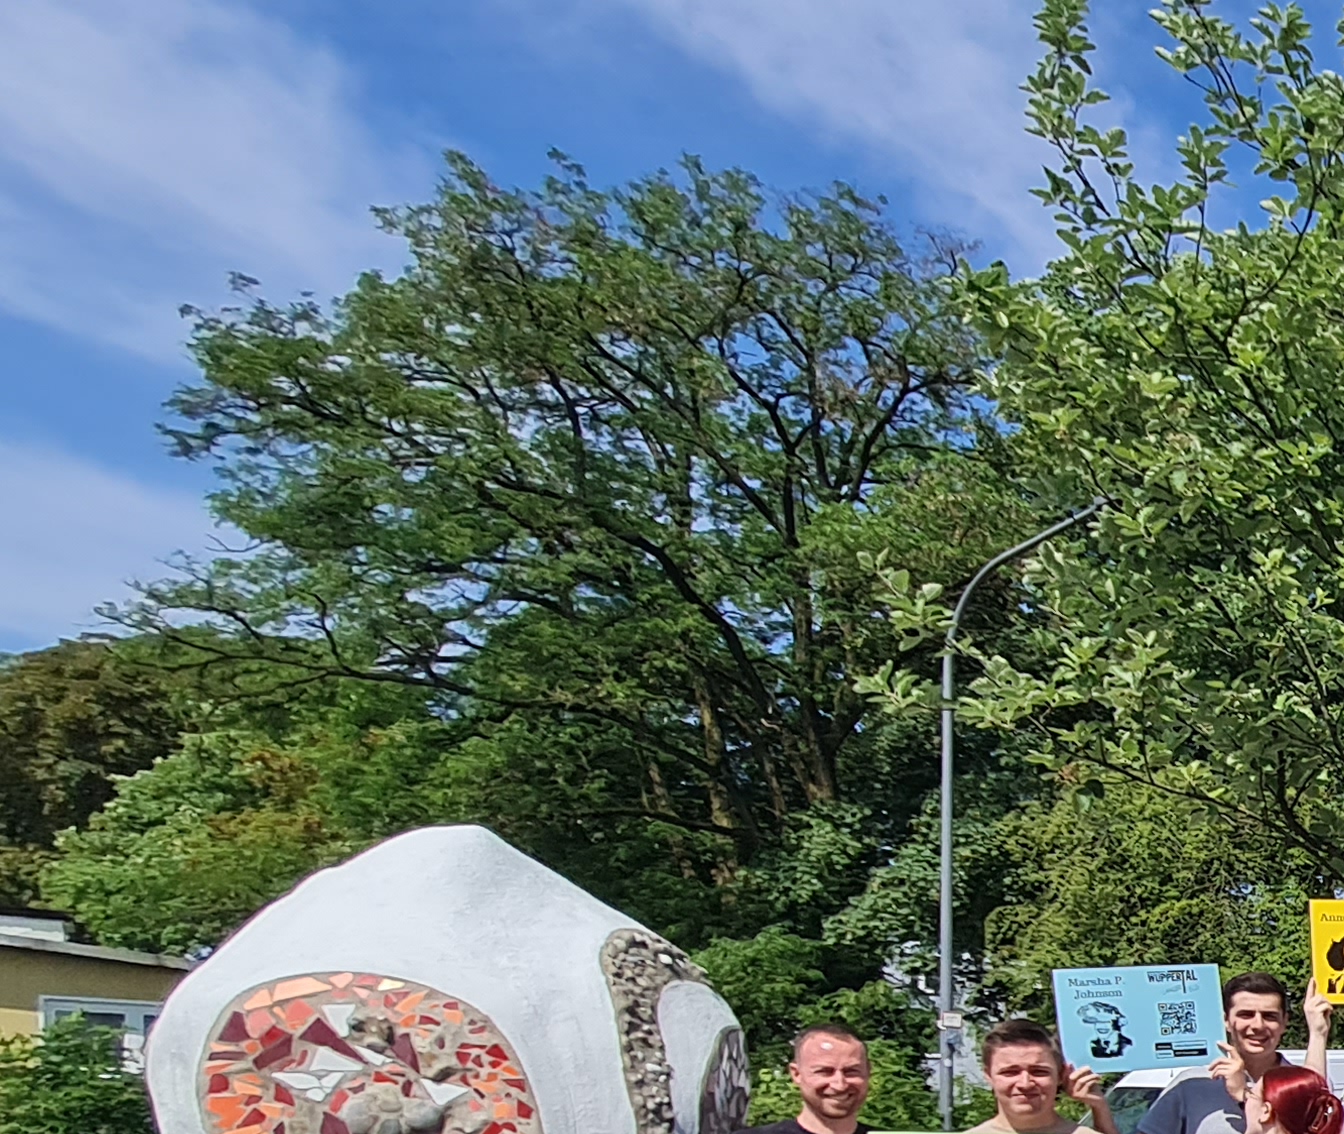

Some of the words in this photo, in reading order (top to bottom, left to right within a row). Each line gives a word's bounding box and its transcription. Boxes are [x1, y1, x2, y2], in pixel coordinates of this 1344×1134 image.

[1068, 976, 1112, 987] Marsha
[1114, 976, 1126, 986] P.
[1147, 970, 1198, 994] WUPPERTAL
[1074, 990, 1123, 1000] Johnson
